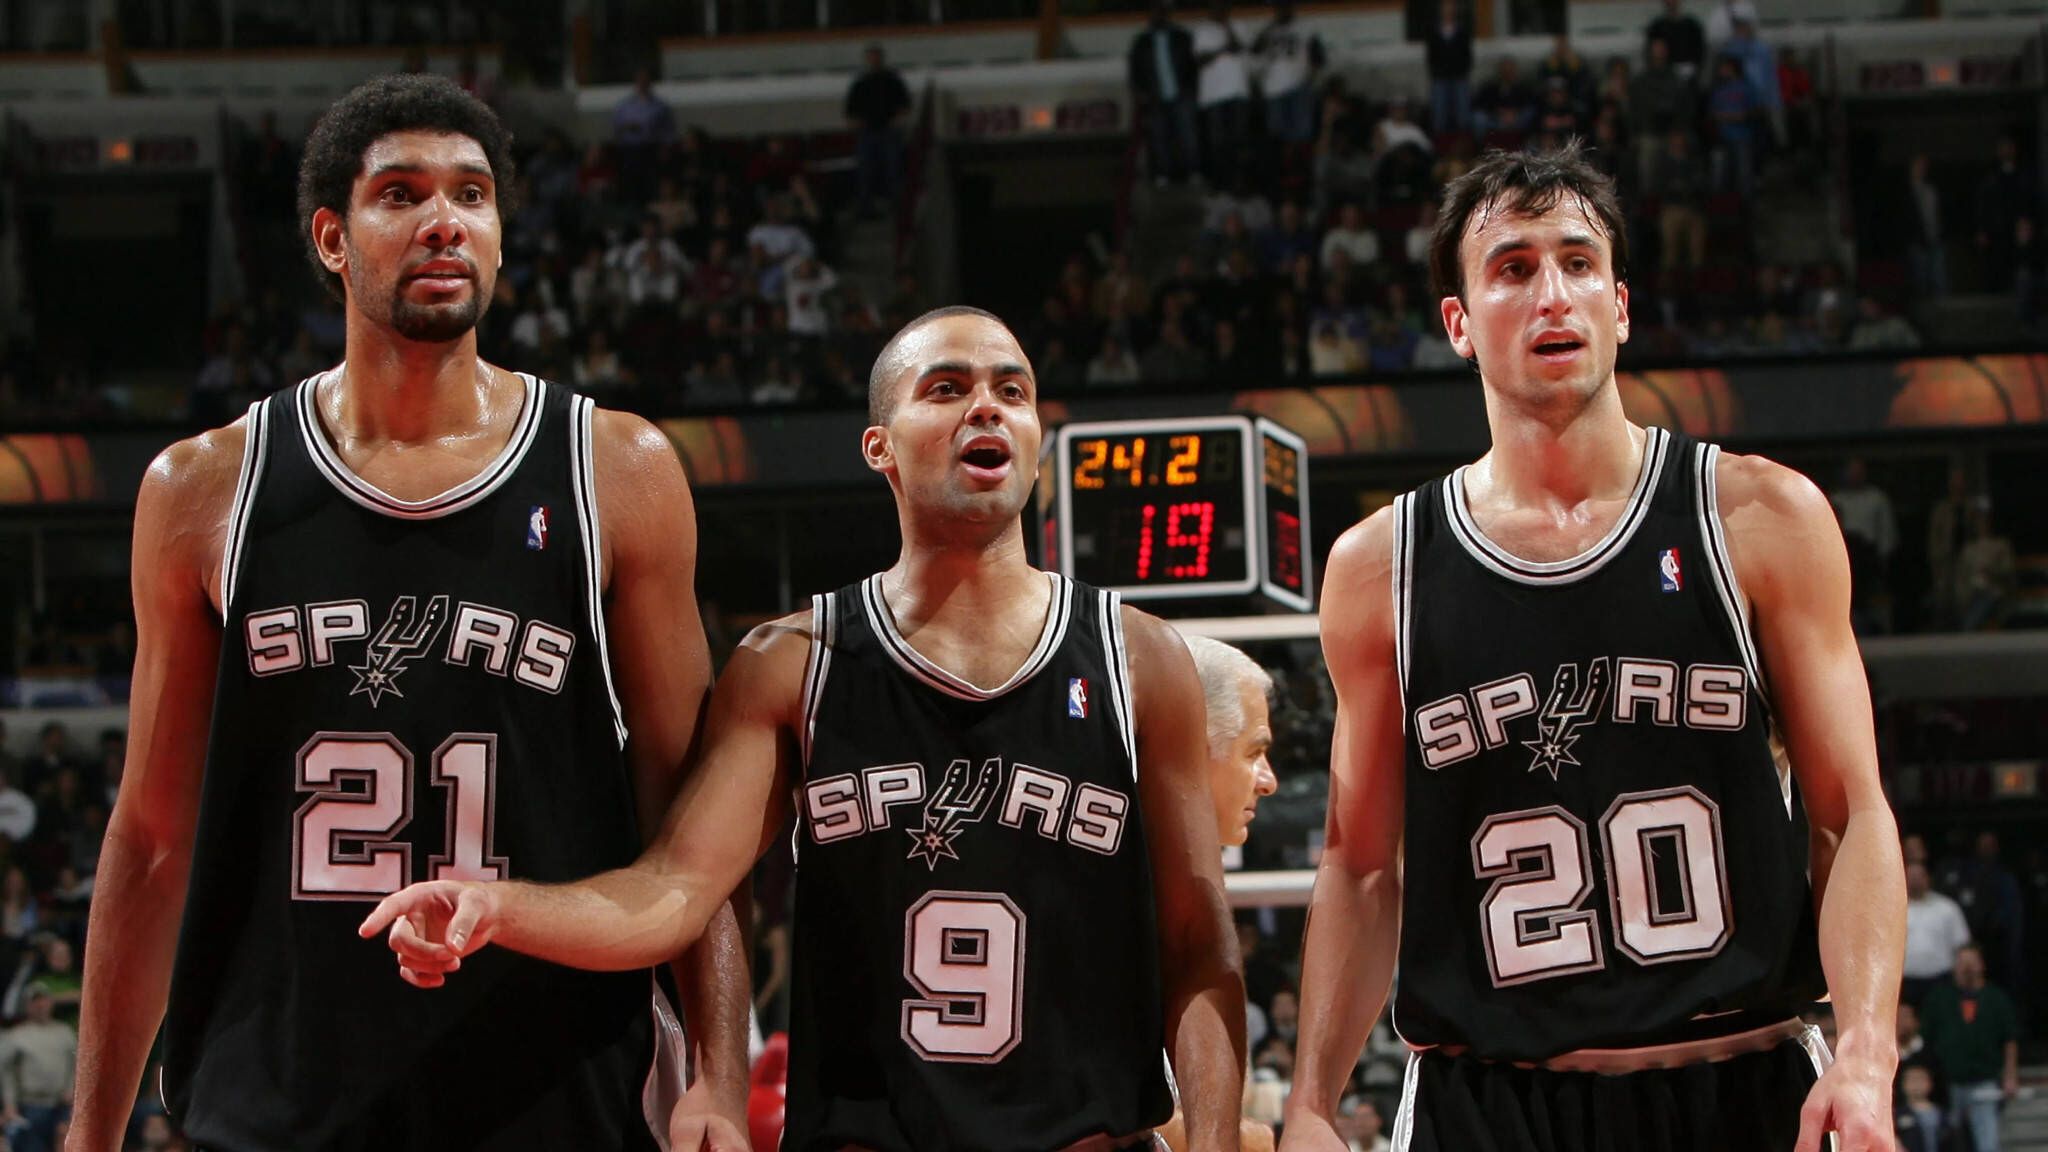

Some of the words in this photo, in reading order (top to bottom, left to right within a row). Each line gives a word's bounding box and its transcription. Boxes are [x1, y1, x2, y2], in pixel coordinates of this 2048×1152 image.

[1074, 435, 1200, 490] 24.2
[1136, 502, 1214, 579] 19
[244, 595, 576, 706] SPURS
[1414, 656, 1748, 781] SPURS
[291, 731, 509, 901] 21
[805, 755, 1129, 871] SPURS
[1471, 785, 1735, 988] 20
[901, 890, 1027, 1064] 9
